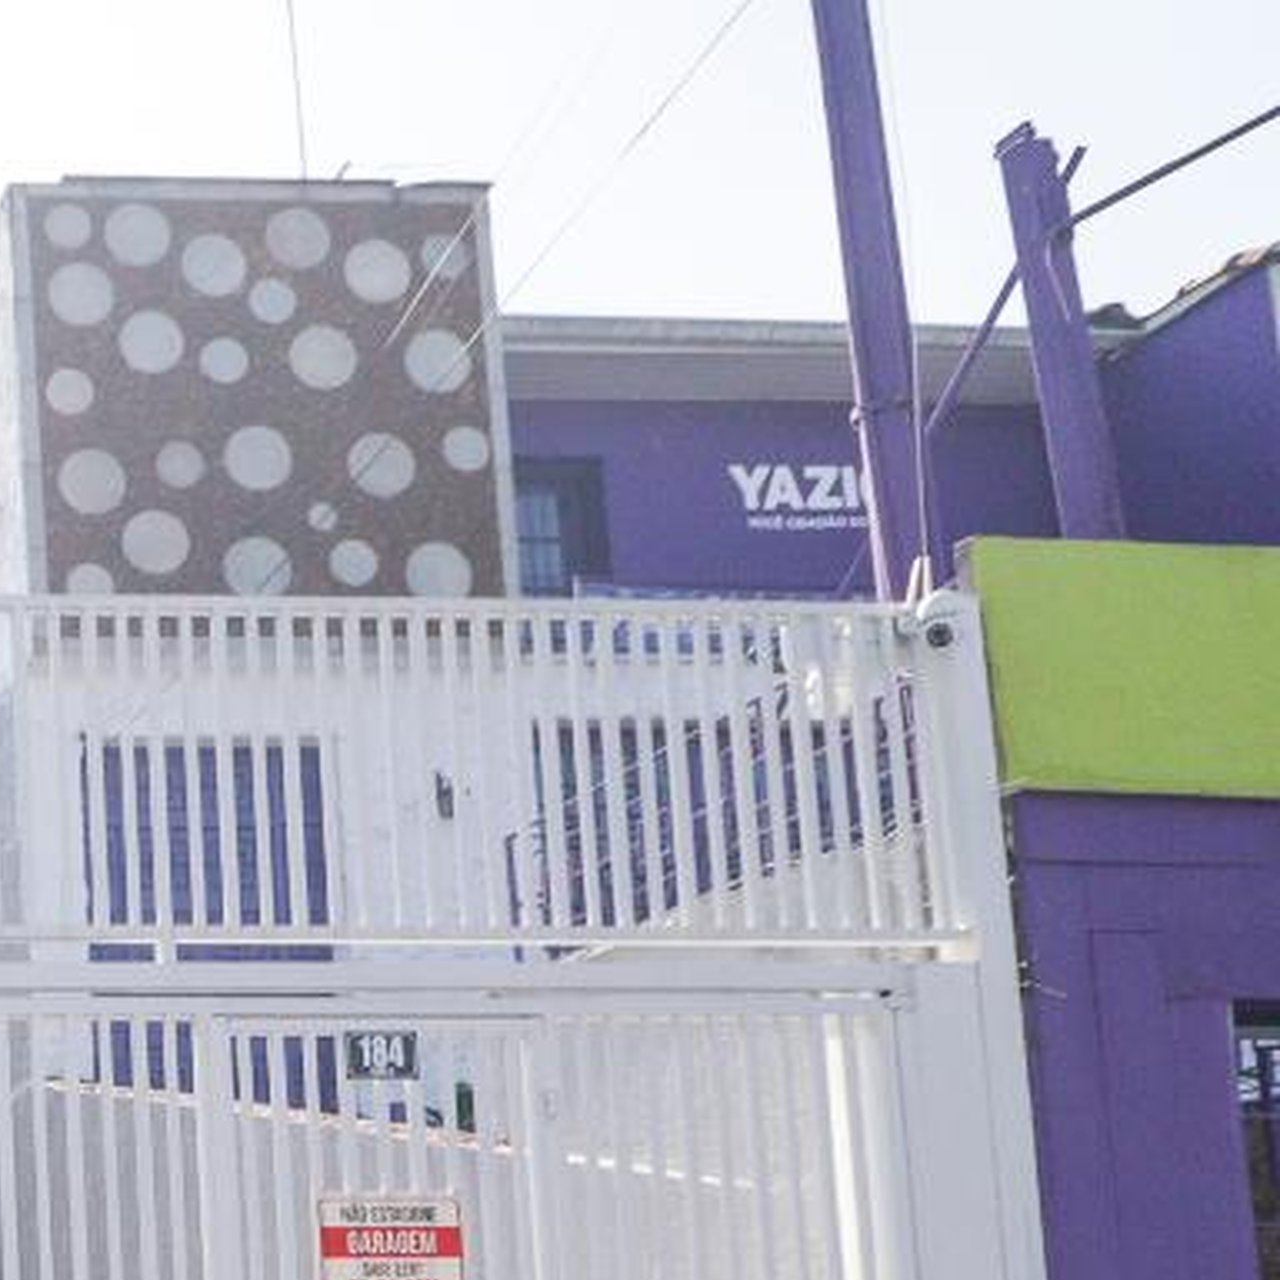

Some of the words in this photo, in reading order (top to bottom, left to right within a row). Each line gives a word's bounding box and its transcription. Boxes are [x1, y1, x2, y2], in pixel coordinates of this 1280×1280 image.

[727, 464, 871, 510] YAZI
[358, 1035, 405, 1068] 184
[346, 1229, 438, 1254] GARAGEM
